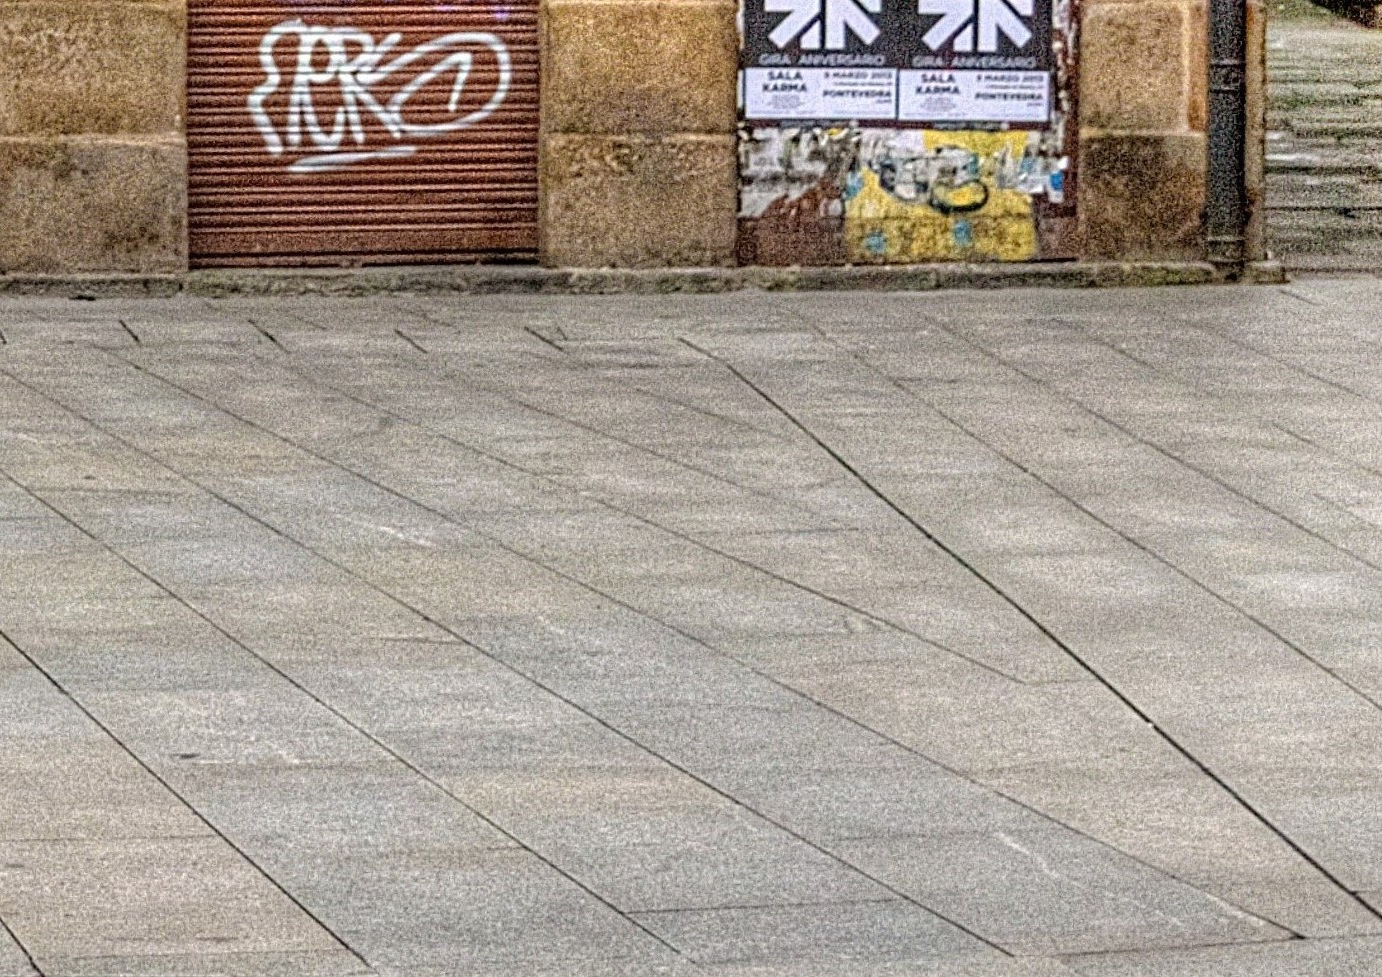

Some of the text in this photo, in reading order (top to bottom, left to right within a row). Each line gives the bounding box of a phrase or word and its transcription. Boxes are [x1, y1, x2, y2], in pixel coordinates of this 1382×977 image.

[768, 71, 803, 81] SALA
[921, 74, 956, 83] SALA
[762, 83, 808, 92] KARMA
[916, 86, 960, 94] KARMA
[822, 90, 892, 98] PONTEVEDRA
[974, 92, 1043, 100] PONTEVEDRA
